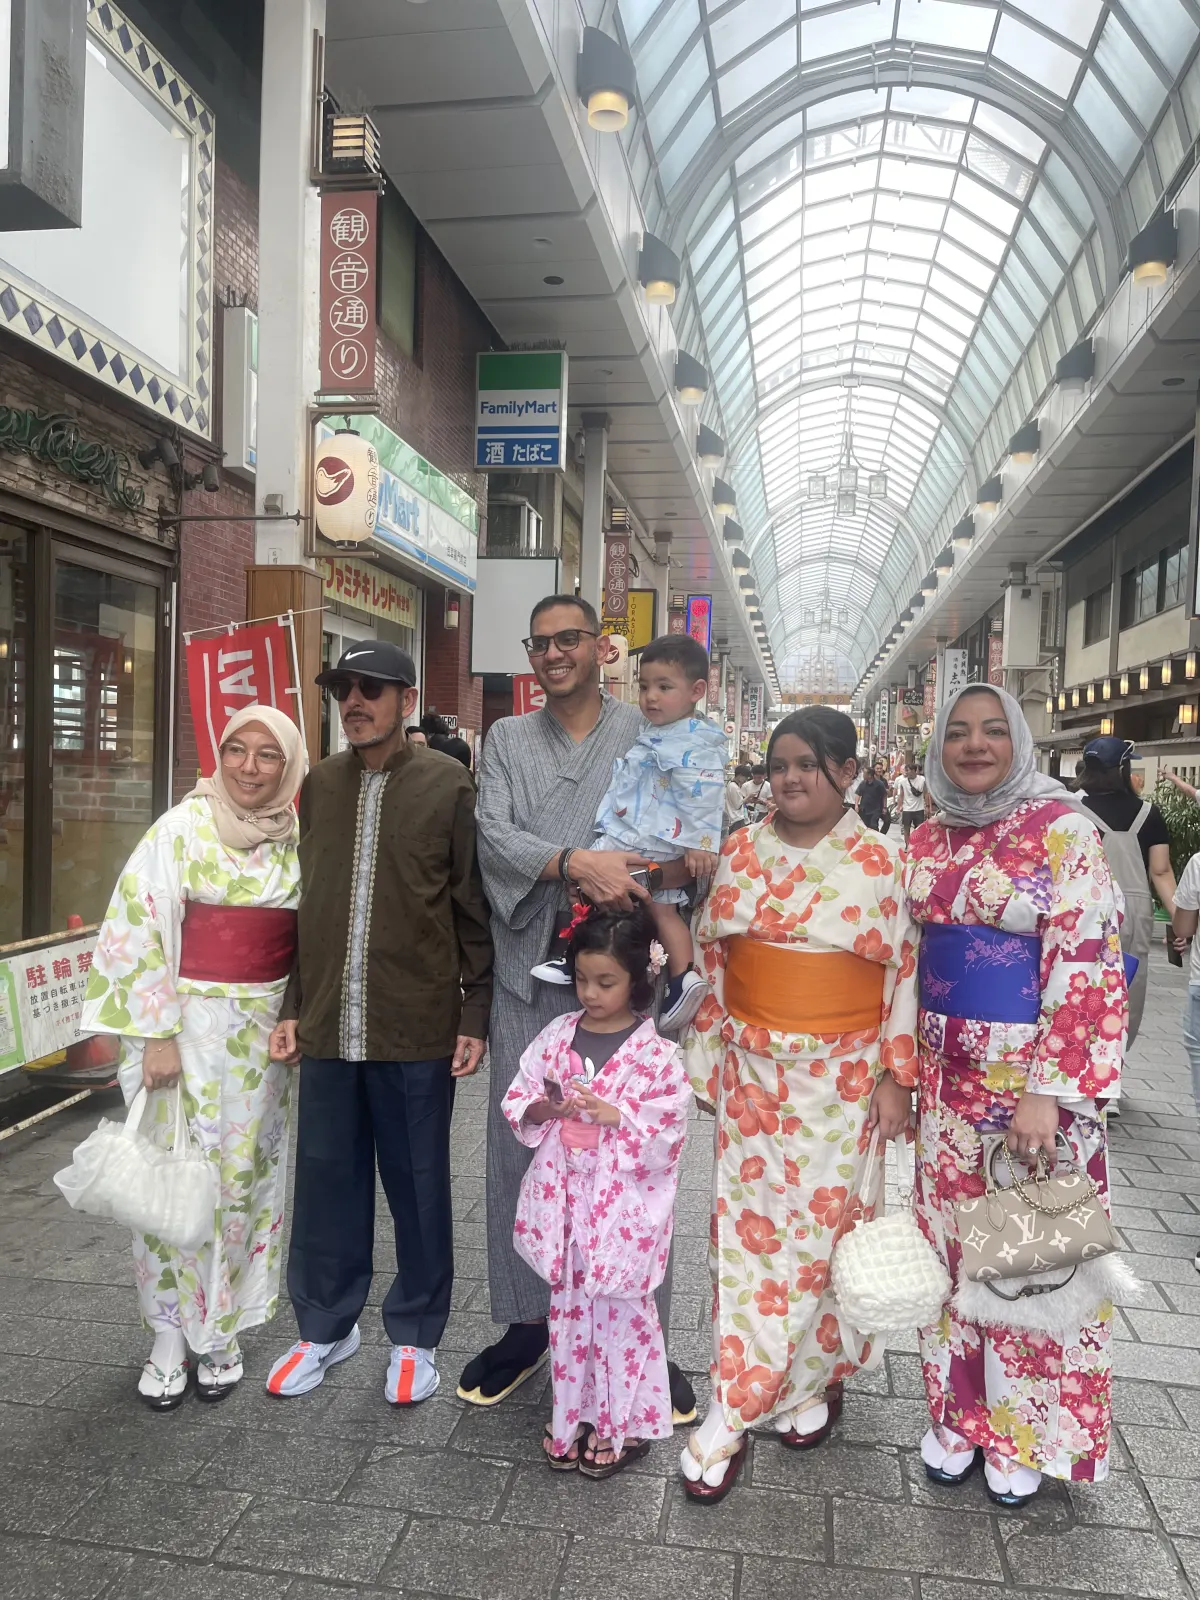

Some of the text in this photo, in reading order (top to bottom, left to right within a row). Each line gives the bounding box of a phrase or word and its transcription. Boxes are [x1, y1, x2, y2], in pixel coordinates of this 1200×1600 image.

[331, 210, 368, 378] 観音通り
[480, 400, 557, 416] FamilyMart
[485, 442, 552, 463] 酒 たばこ
[609, 541, 626, 613] 観音通り
